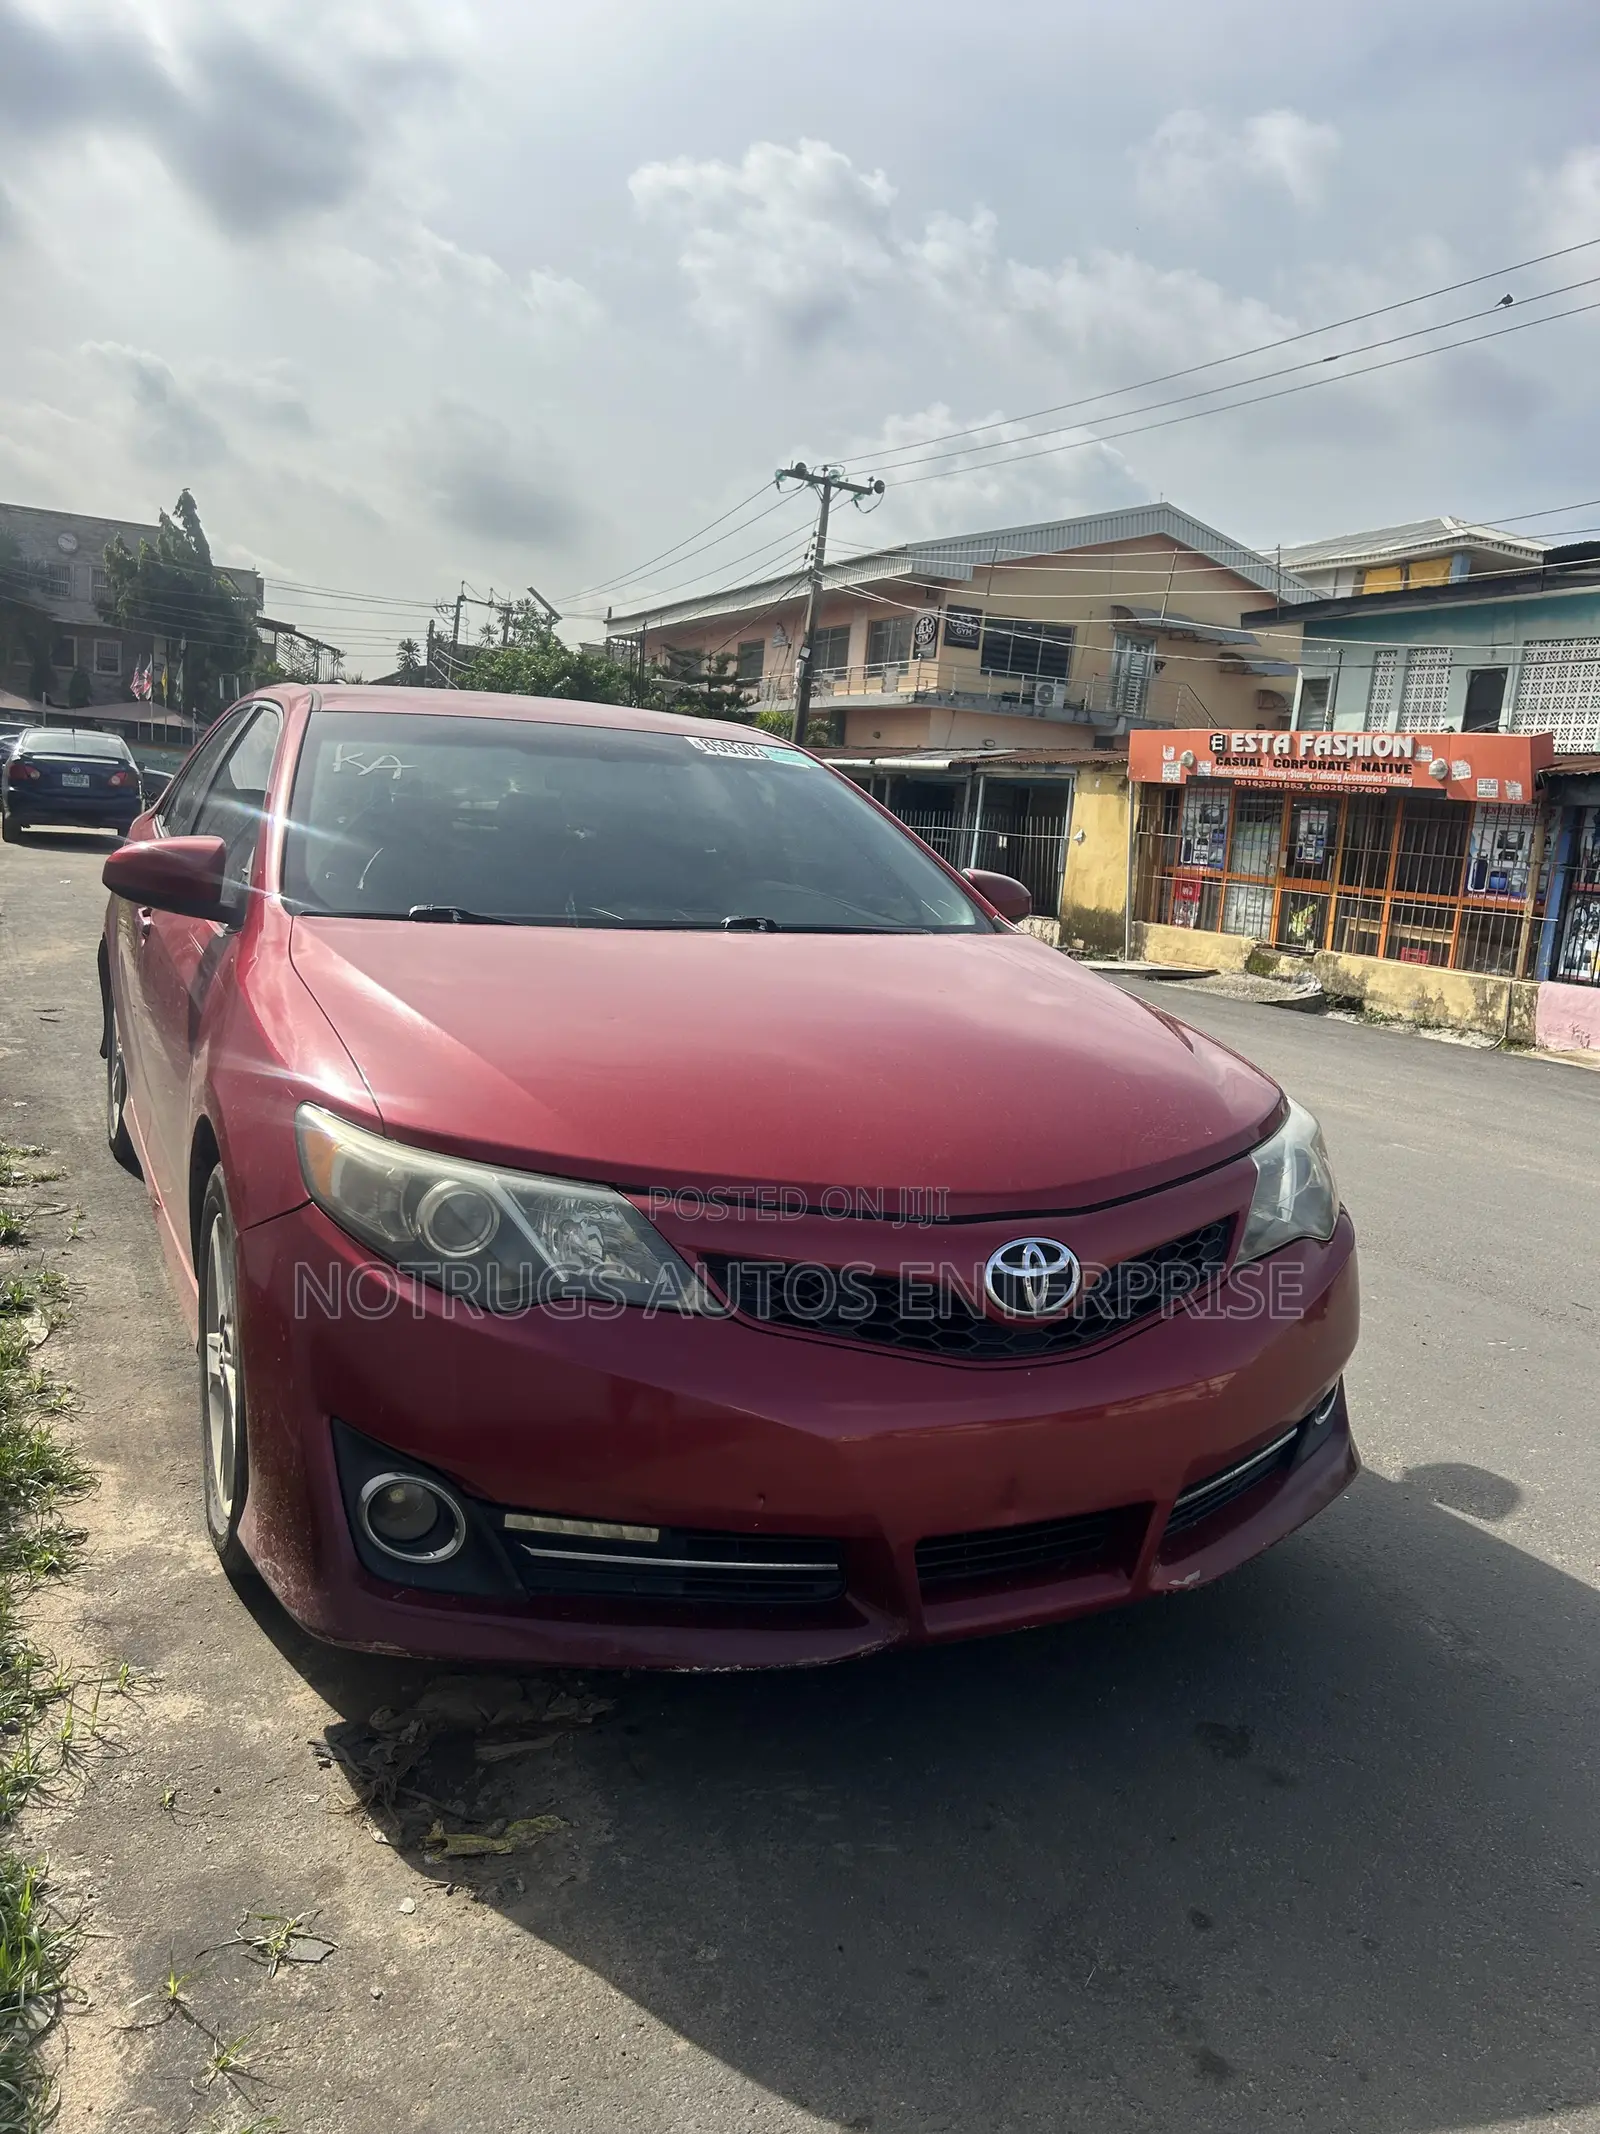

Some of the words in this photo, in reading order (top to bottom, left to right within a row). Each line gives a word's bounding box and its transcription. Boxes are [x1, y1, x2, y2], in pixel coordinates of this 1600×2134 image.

[956, 628, 973, 636] GYM
[1231, 733, 1291, 756] ESTA
[1300, 734, 1415, 759] FASHION
[332, 743, 418, 780] KA
[1215, 757, 1263, 768] CASUAL
[1273, 758, 1351, 772] CORPORATE
[1361, 762, 1412, 774] NATIVE
[1316, 771, 1342, 783] Tailoring
[1343, 773, 1382, 783] Accessories
[1386, 774, 1413, 787] Training
